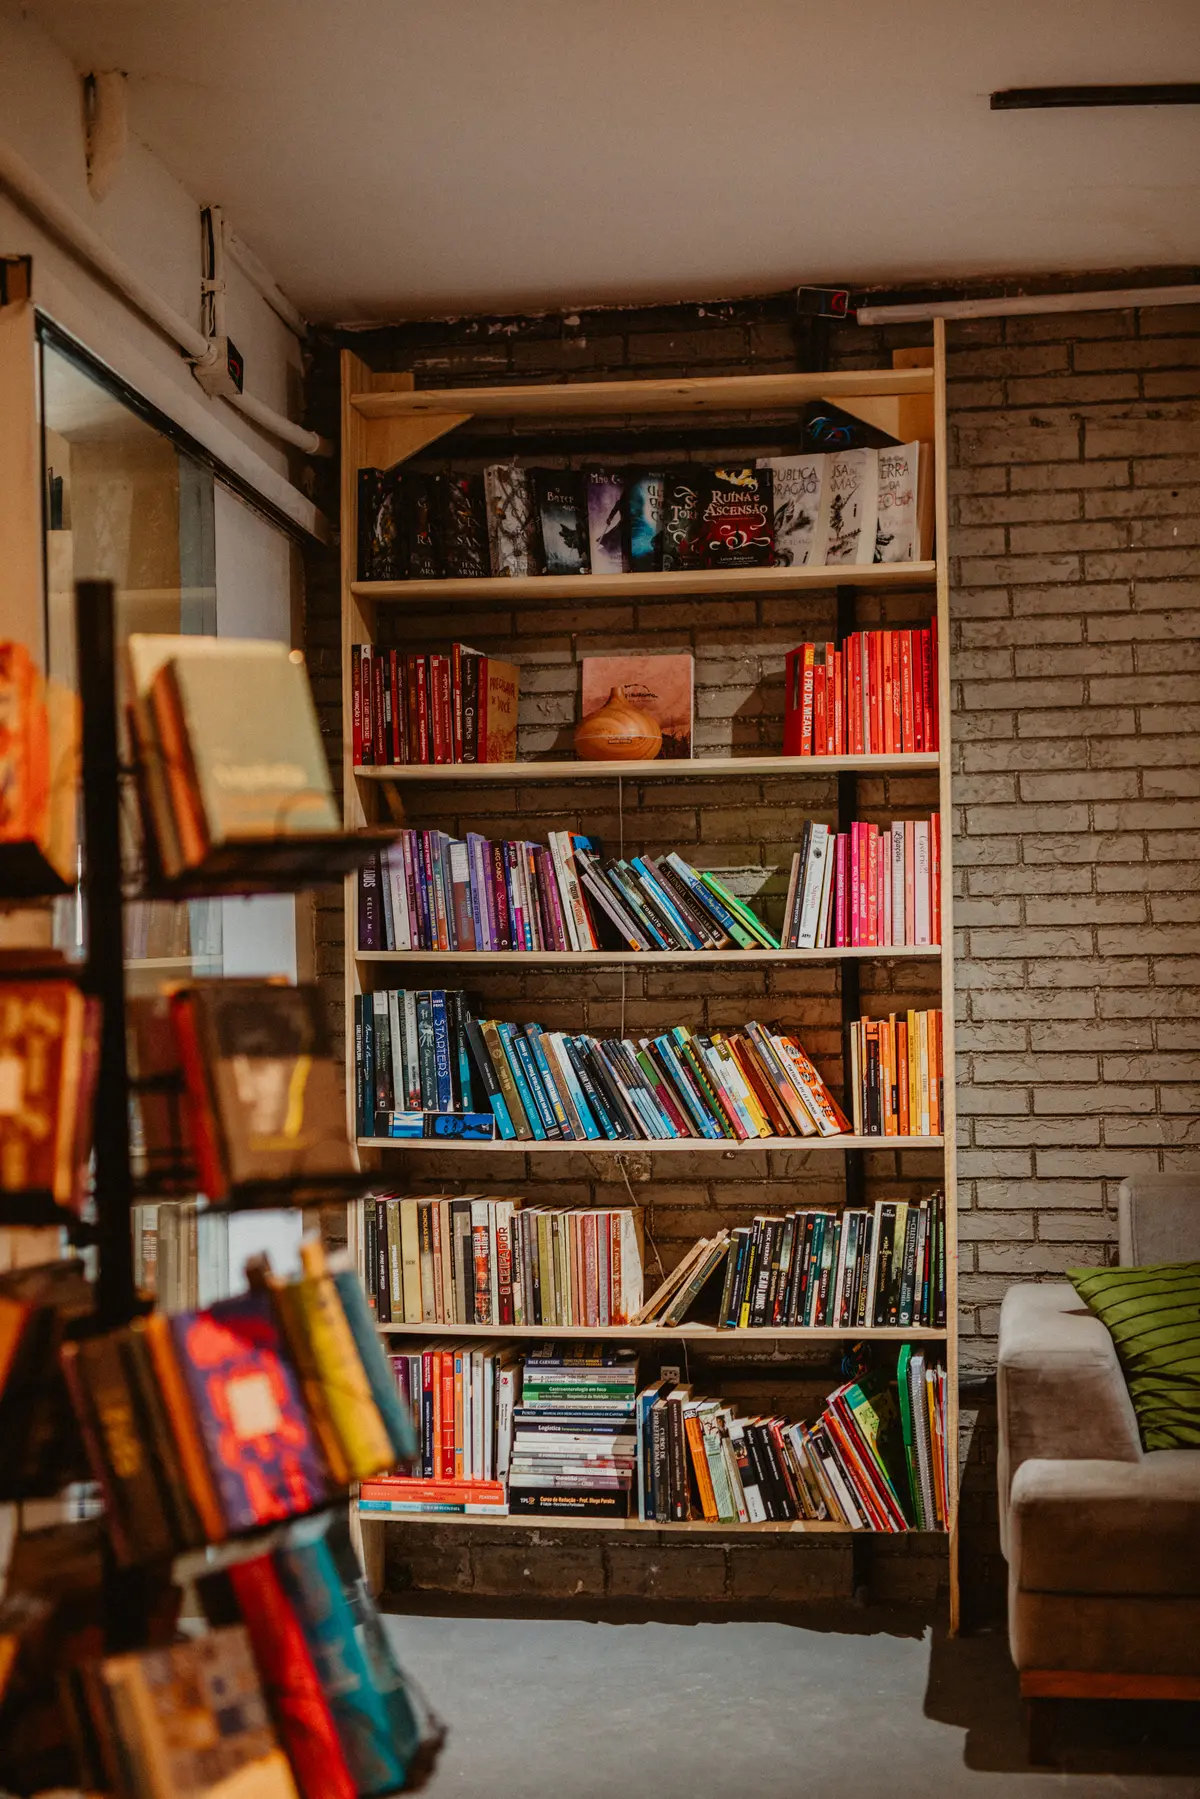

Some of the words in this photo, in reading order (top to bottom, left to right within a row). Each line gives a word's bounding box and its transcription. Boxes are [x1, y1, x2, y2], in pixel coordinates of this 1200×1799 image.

[711, 489, 752, 505] RUÍNA
[703, 503, 769, 517] ASCENSÃO
[804, 679, 813, 692] FIO
[354, 690, 362, 717] MOTIVAÇÃO
[803, 693, 813, 705] DA
[802, 706, 812, 737] MEADA
[894, 831, 904, 863] Ligações
[662, 869, 690, 898] ALIENISTA
[809, 885, 819, 909] Sapiens
[642, 904, 662, 928] CONFLITO
[366, 924, 373, 933] M.
[434, 1019, 449, 1077] STARTERS
[908, 1223, 917, 1253] CELESTINE
[498, 1227, 511, 1284] CEIFADOR
[762, 1242, 771, 1265] HERRON
[907, 1255, 915, 1276] VISION
[758, 1270, 770, 1289] DEAD
[778, 1272, 786, 1301] CONFLITO
[820, 1269, 828, 1299] CONFLITO
[844, 1269, 852, 1298] CONFLITO
[755, 1289, 768, 1310] LIONS
[660, 1451, 666, 1460] DE
